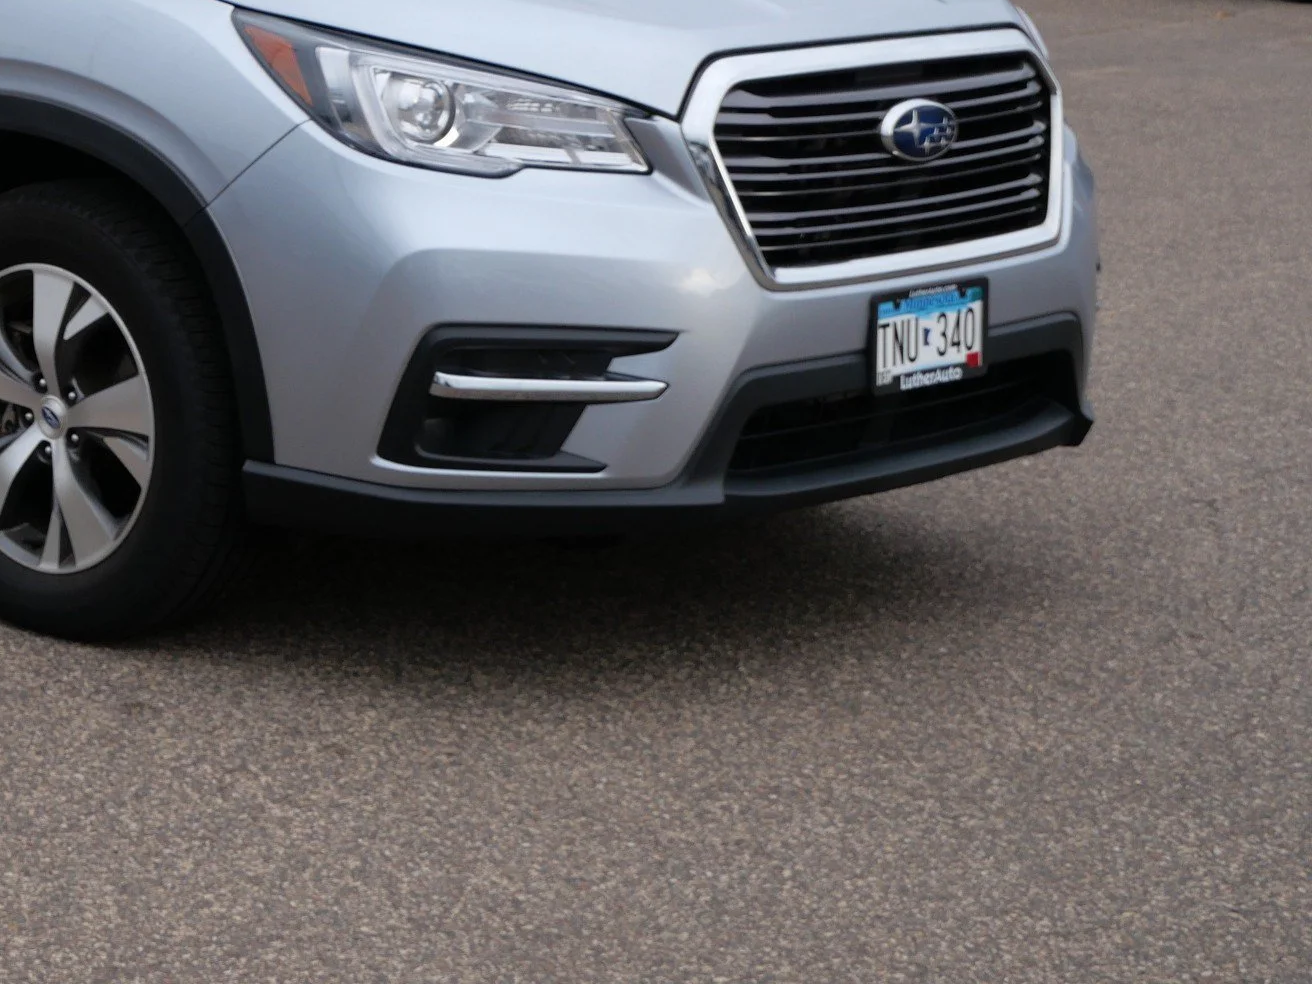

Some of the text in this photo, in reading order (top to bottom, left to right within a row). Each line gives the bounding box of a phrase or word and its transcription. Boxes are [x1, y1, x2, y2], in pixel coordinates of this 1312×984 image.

[878, 307, 975, 369] TNU 340
[899, 366, 964, 391] LutherAuto
